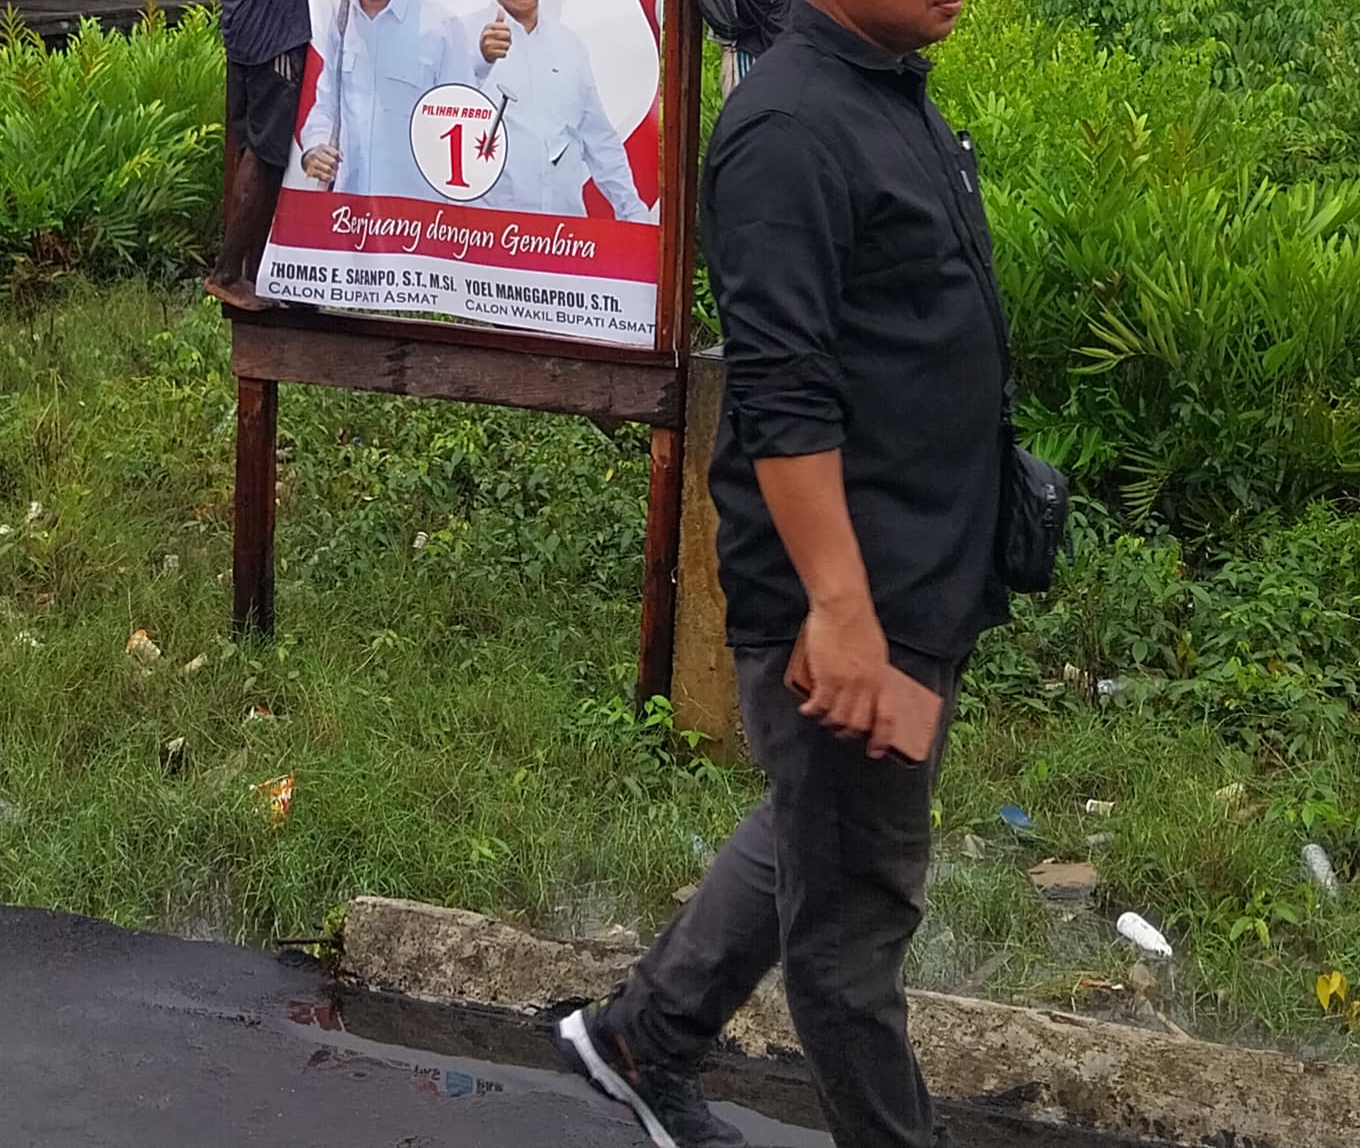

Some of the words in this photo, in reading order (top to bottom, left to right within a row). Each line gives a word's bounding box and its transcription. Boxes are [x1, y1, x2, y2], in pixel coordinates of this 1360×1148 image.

[422, 104, 460, 118] PILIHAN
[461, 107, 493, 120] ABADI
[440, 123, 470, 188] 1
[332, 205, 422, 253] Berjuang
[426, 209, 495, 260] dengan
[500, 223, 596, 259] Gembira
[270, 261, 328, 284] THOMAS
[346, 268, 399, 288] SAFANPO,
[465, 279, 494, 298] YOEL
[495, 283, 589, 311] MANGGAPROU,
[590, 293, 623, 313] S.Th.
